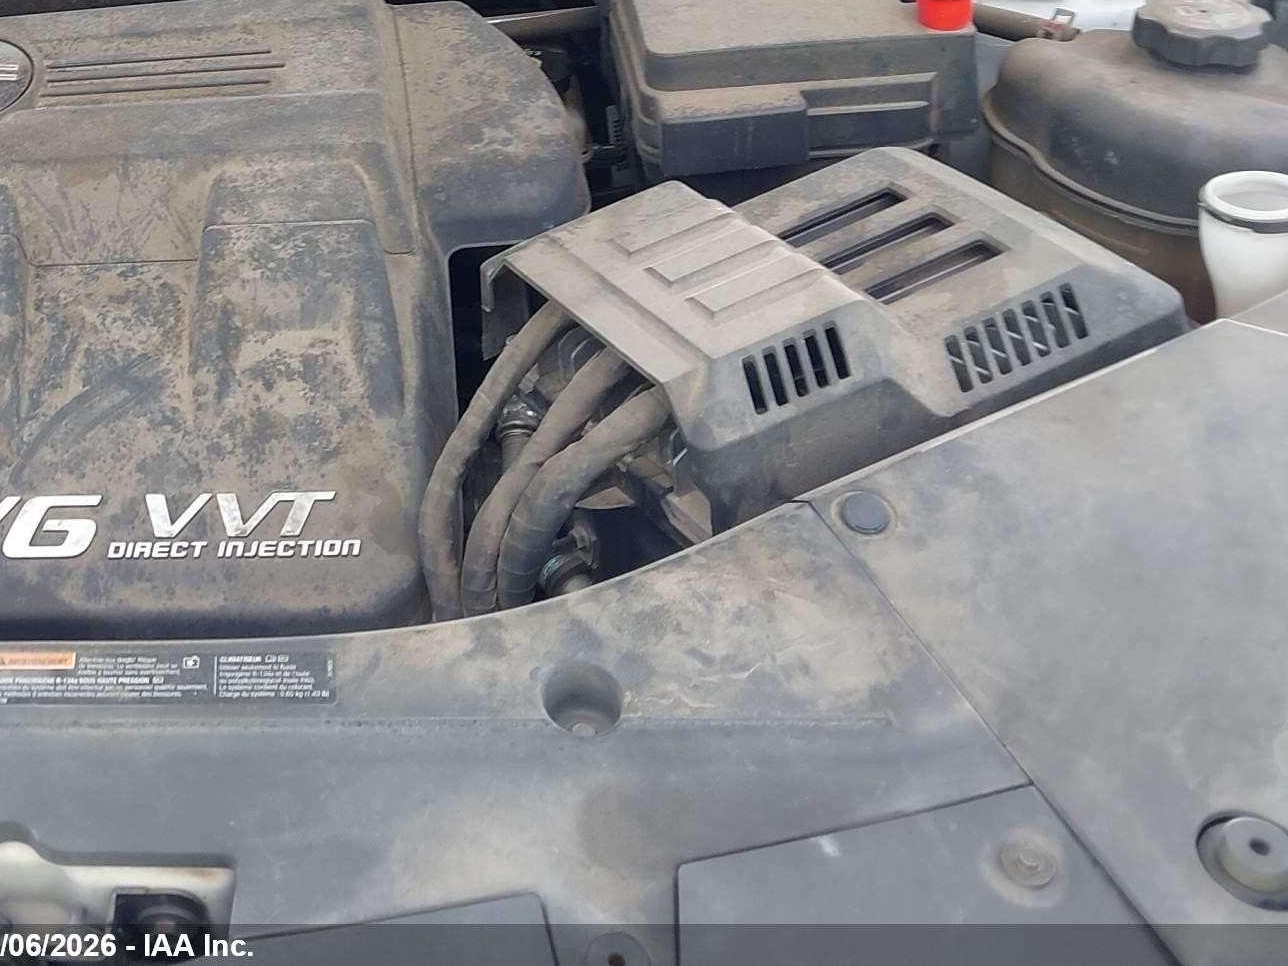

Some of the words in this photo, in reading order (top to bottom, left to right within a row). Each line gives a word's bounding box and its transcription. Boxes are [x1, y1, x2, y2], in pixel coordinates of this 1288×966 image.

[145, 491, 336, 538] VVT
[107, 541, 208, 559] DIRECT
[217, 539, 361, 558] INJECTION
